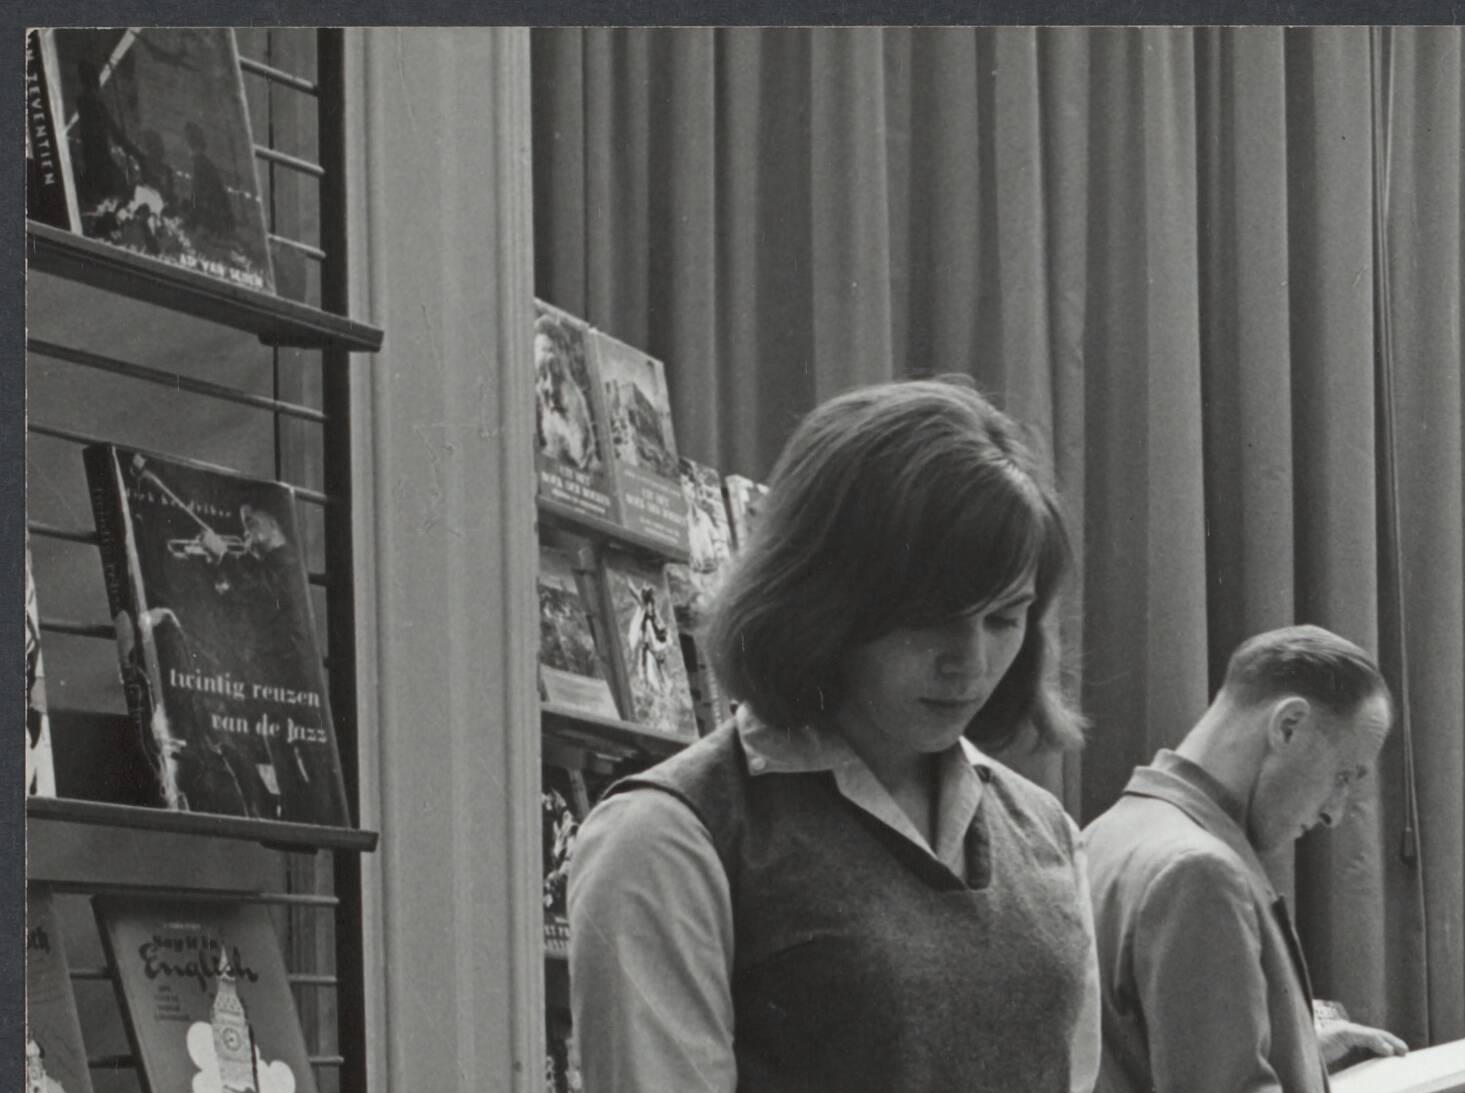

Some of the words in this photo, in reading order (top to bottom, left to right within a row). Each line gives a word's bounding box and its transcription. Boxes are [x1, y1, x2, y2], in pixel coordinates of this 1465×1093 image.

[170, 668, 246, 701] twintig
[252, 683, 320, 708] reuzen
[211, 713, 249, 734] van
[255, 712, 280, 737] de
[138, 942, 259, 993] English
